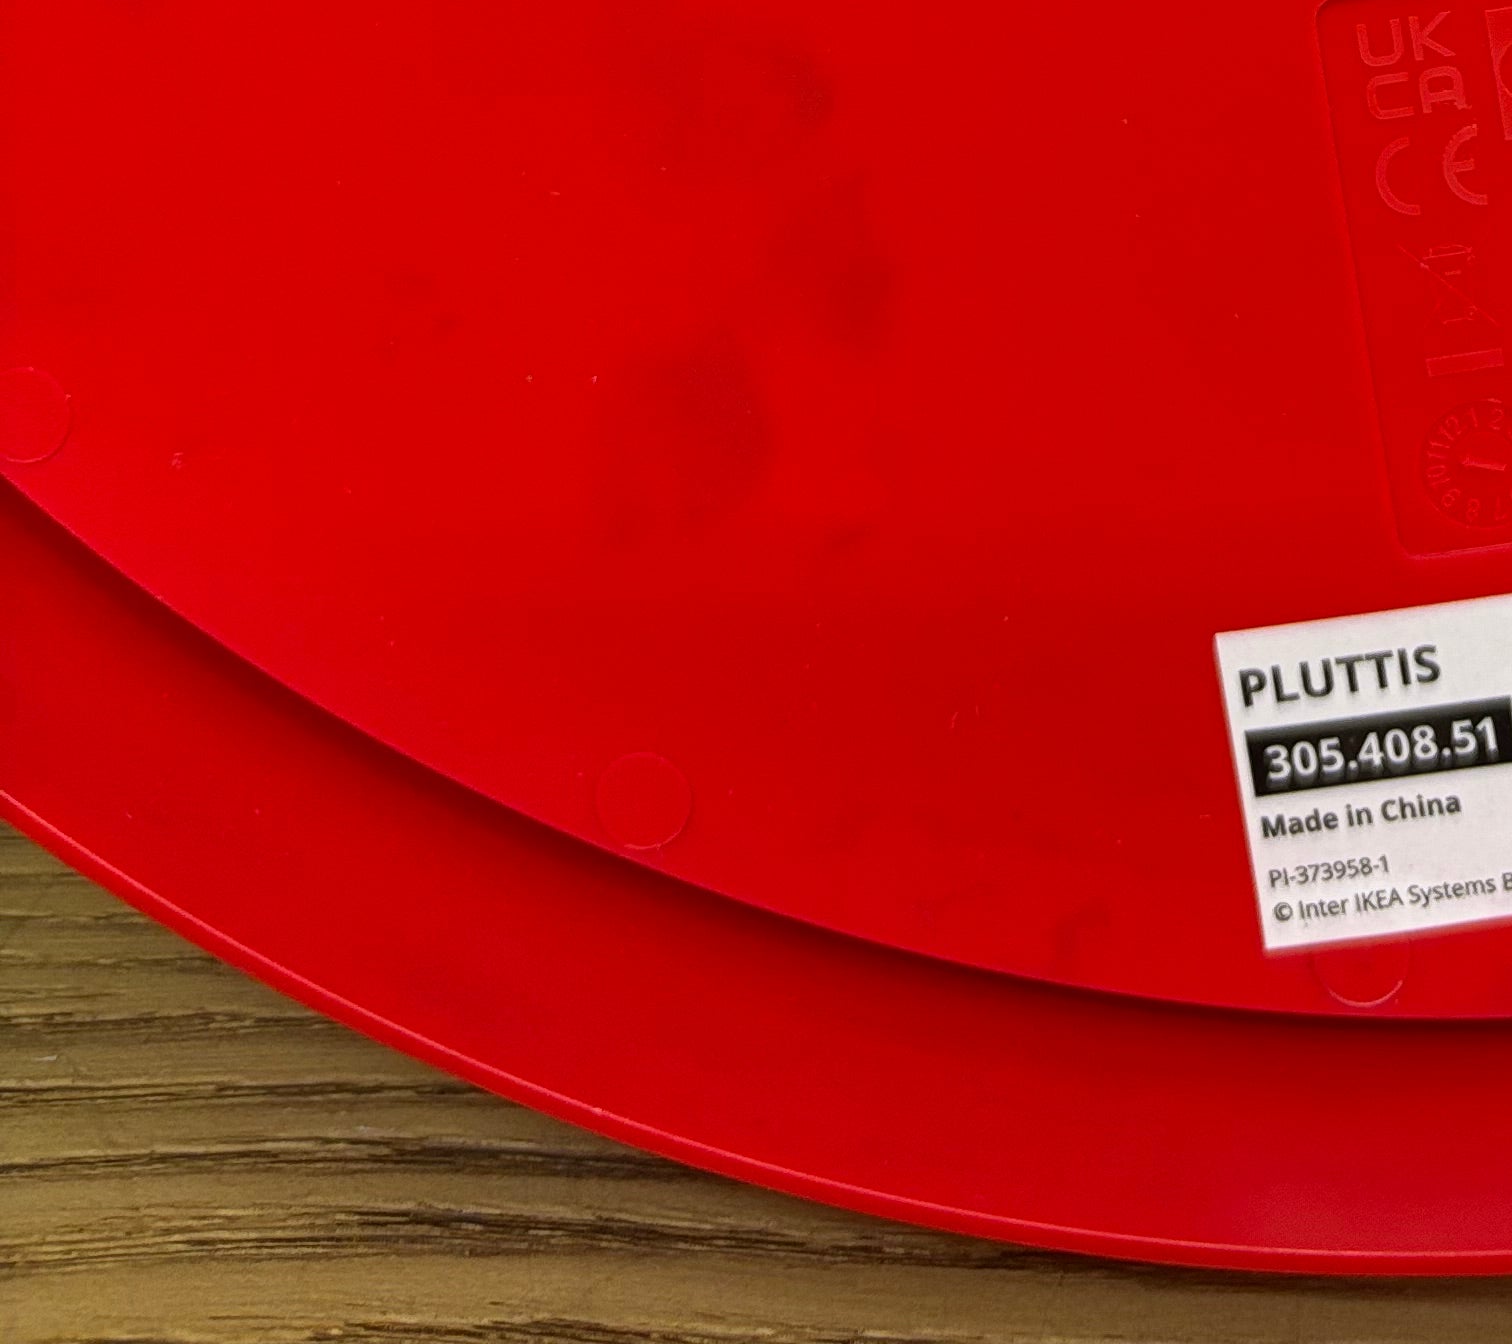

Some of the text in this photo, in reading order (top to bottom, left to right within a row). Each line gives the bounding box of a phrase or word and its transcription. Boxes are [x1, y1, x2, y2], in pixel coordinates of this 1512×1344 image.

[1356, 10, 1456, 67] UK
[1366, 66, 1470, 121] CA
[1376, 124, 1488, 216] CE
[1239, 644, 1441, 707] PLUTTIS
[1264, 716, 1499, 782] 305.408.51
[1261, 795, 1462, 839] Made in China
[1269, 856, 1389, 888] PI-373958-1
[1299, 893, 1348, 920] Inter
[1355, 889, 1405, 913] IKEA
[1409, 877, 1496, 907] Systems
